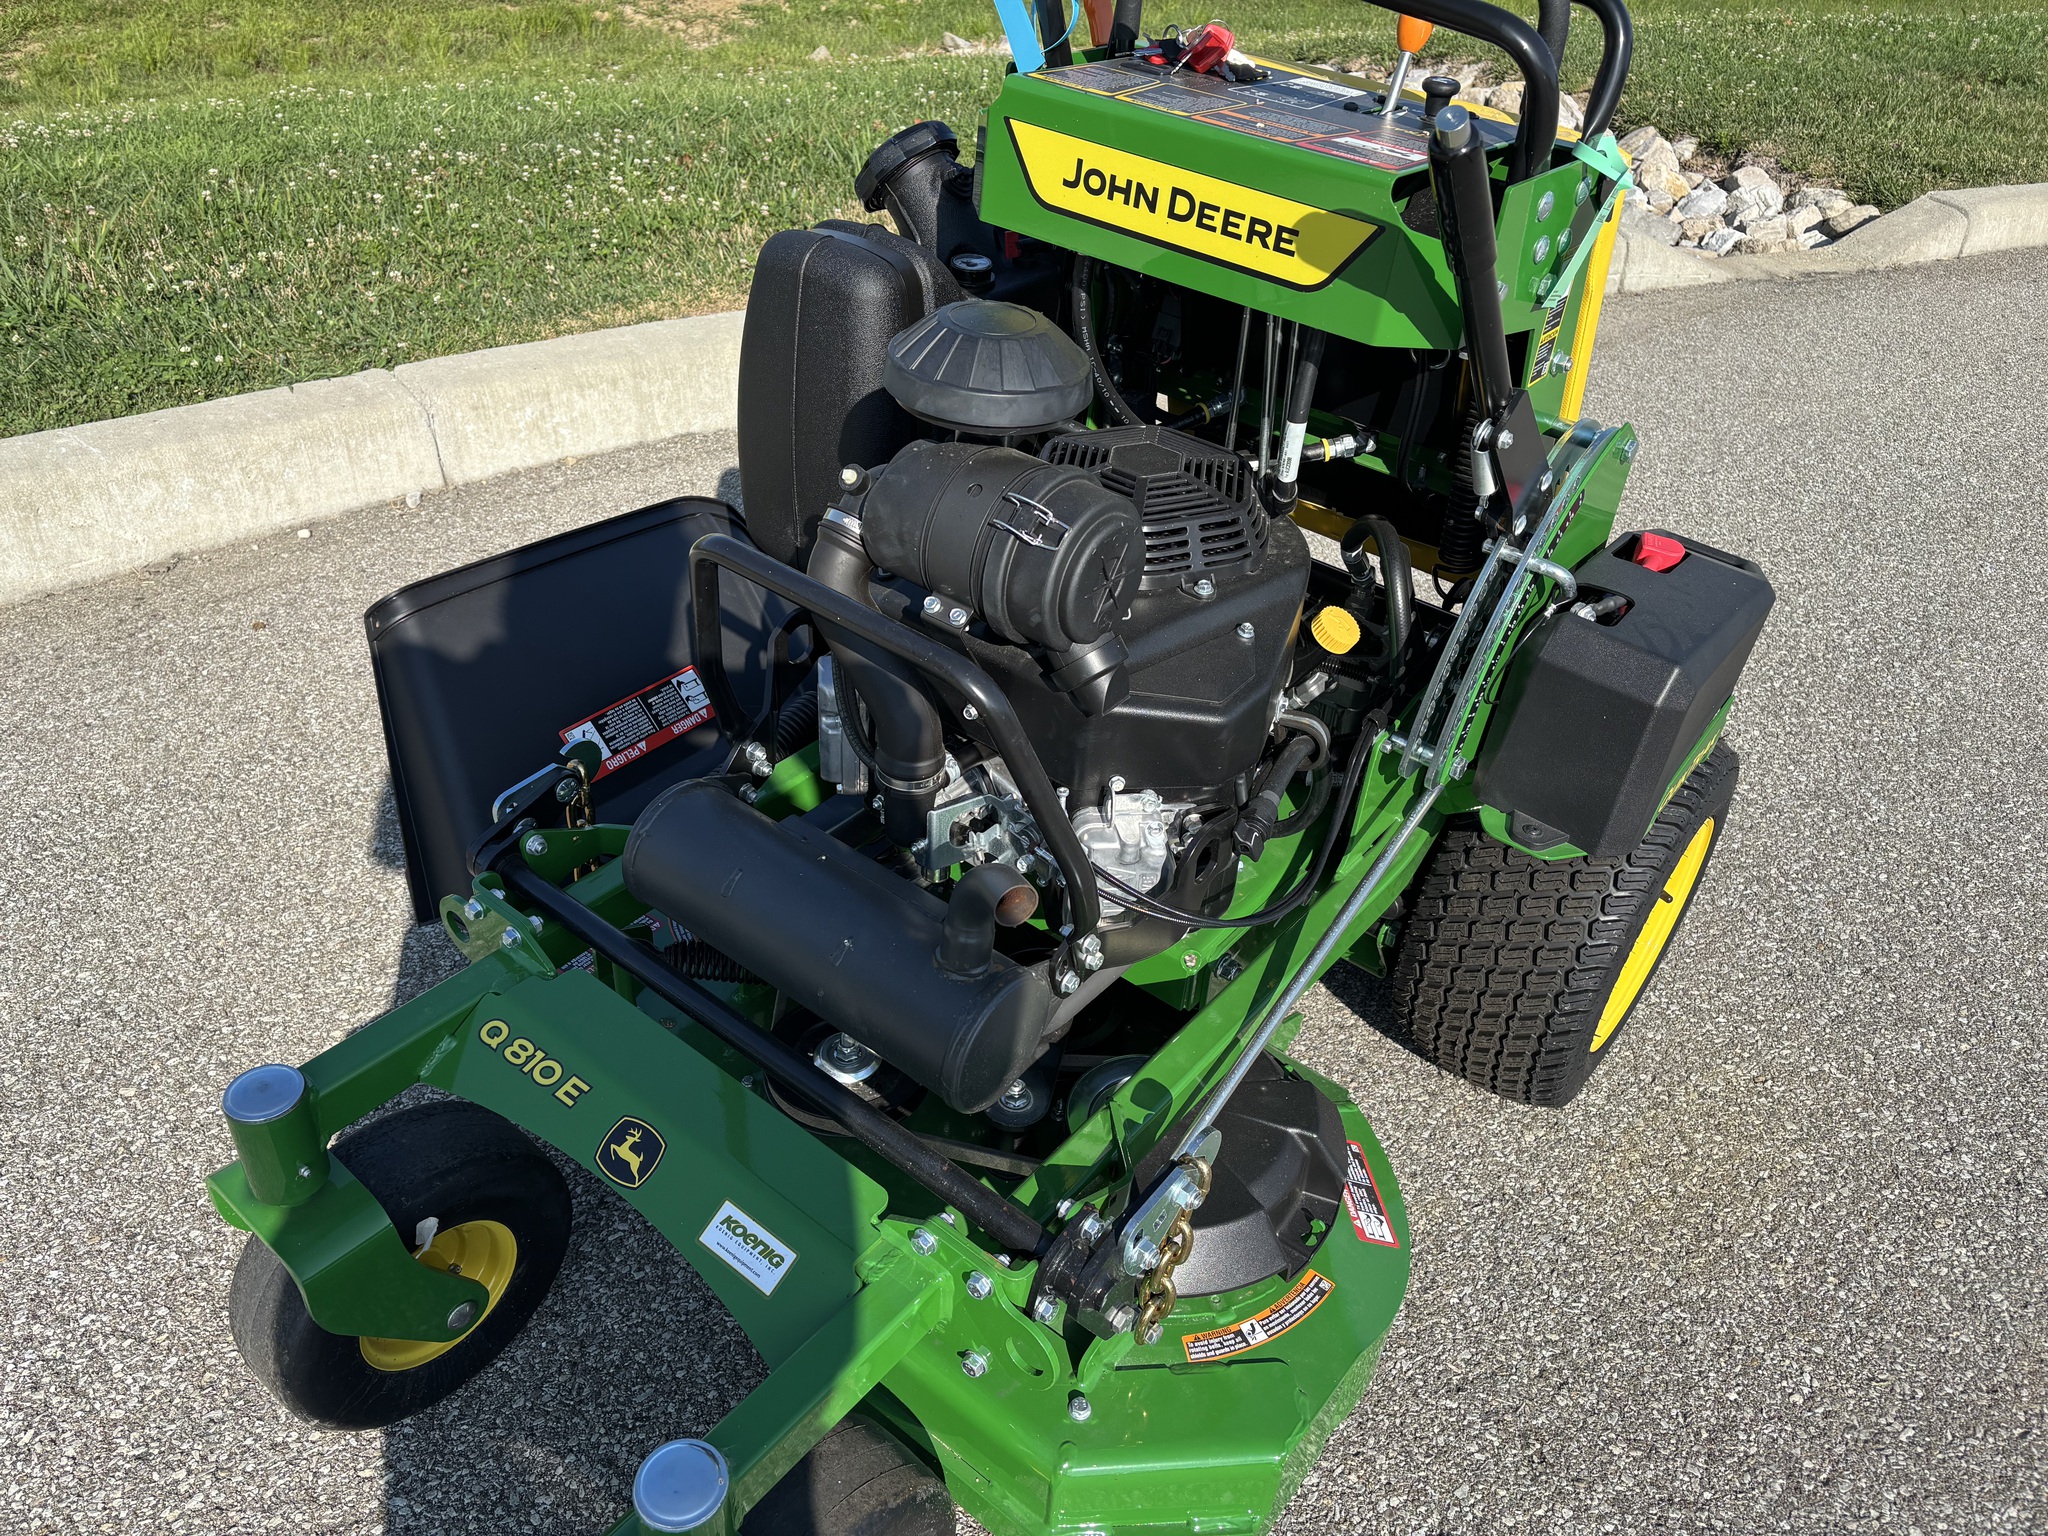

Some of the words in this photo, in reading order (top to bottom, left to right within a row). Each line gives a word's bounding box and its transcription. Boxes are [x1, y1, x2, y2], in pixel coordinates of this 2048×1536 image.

[1063, 158, 1160, 215] JOHN
[1167, 186, 1300, 258] DEERE
[1081, 326, 1091, 352] MSHA
[671, 714, 701, 734] DANGER
[606, 746, 641, 770] PELIGRO
[715, 1224, 733, 1240] KOENIG
[764, 1263, 776, 1275] INC.
[1274, 1282, 1305, 1309] ADVERTENCIA
[1200, 1326, 1232, 1339] WARNING
